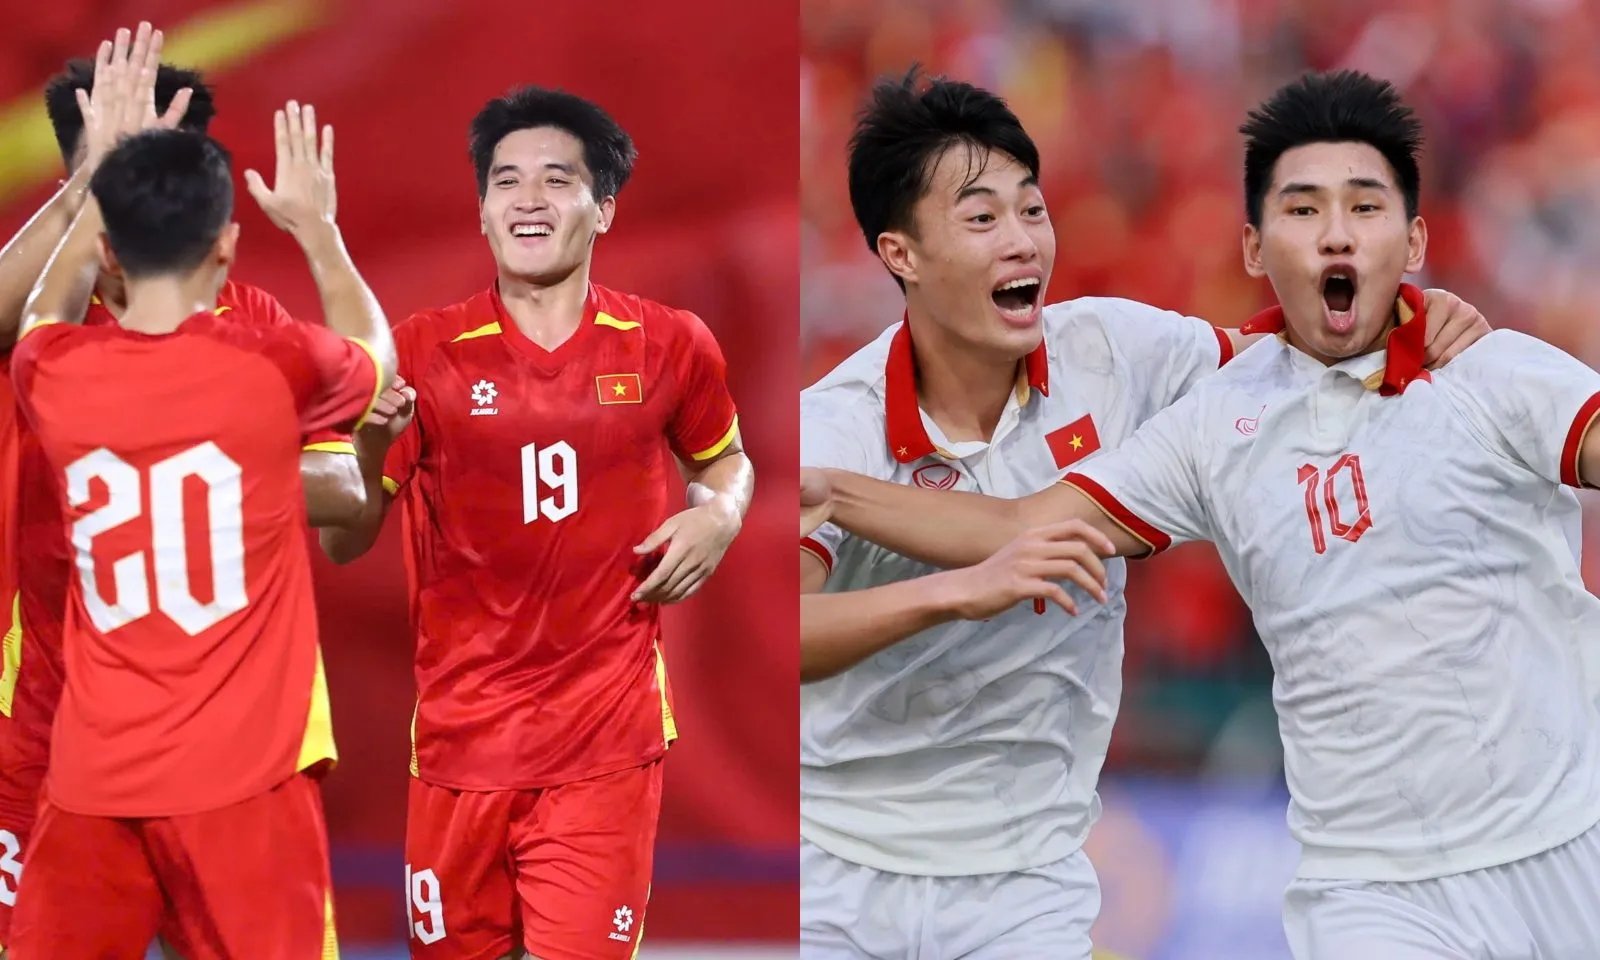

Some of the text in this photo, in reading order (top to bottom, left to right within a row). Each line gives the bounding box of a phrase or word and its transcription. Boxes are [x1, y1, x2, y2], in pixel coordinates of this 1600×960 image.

[521, 440, 578, 524] 19
[1297, 453, 1374, 554] 10
[66, 441, 248, 636] 20
[405, 864, 447, 945] 19
